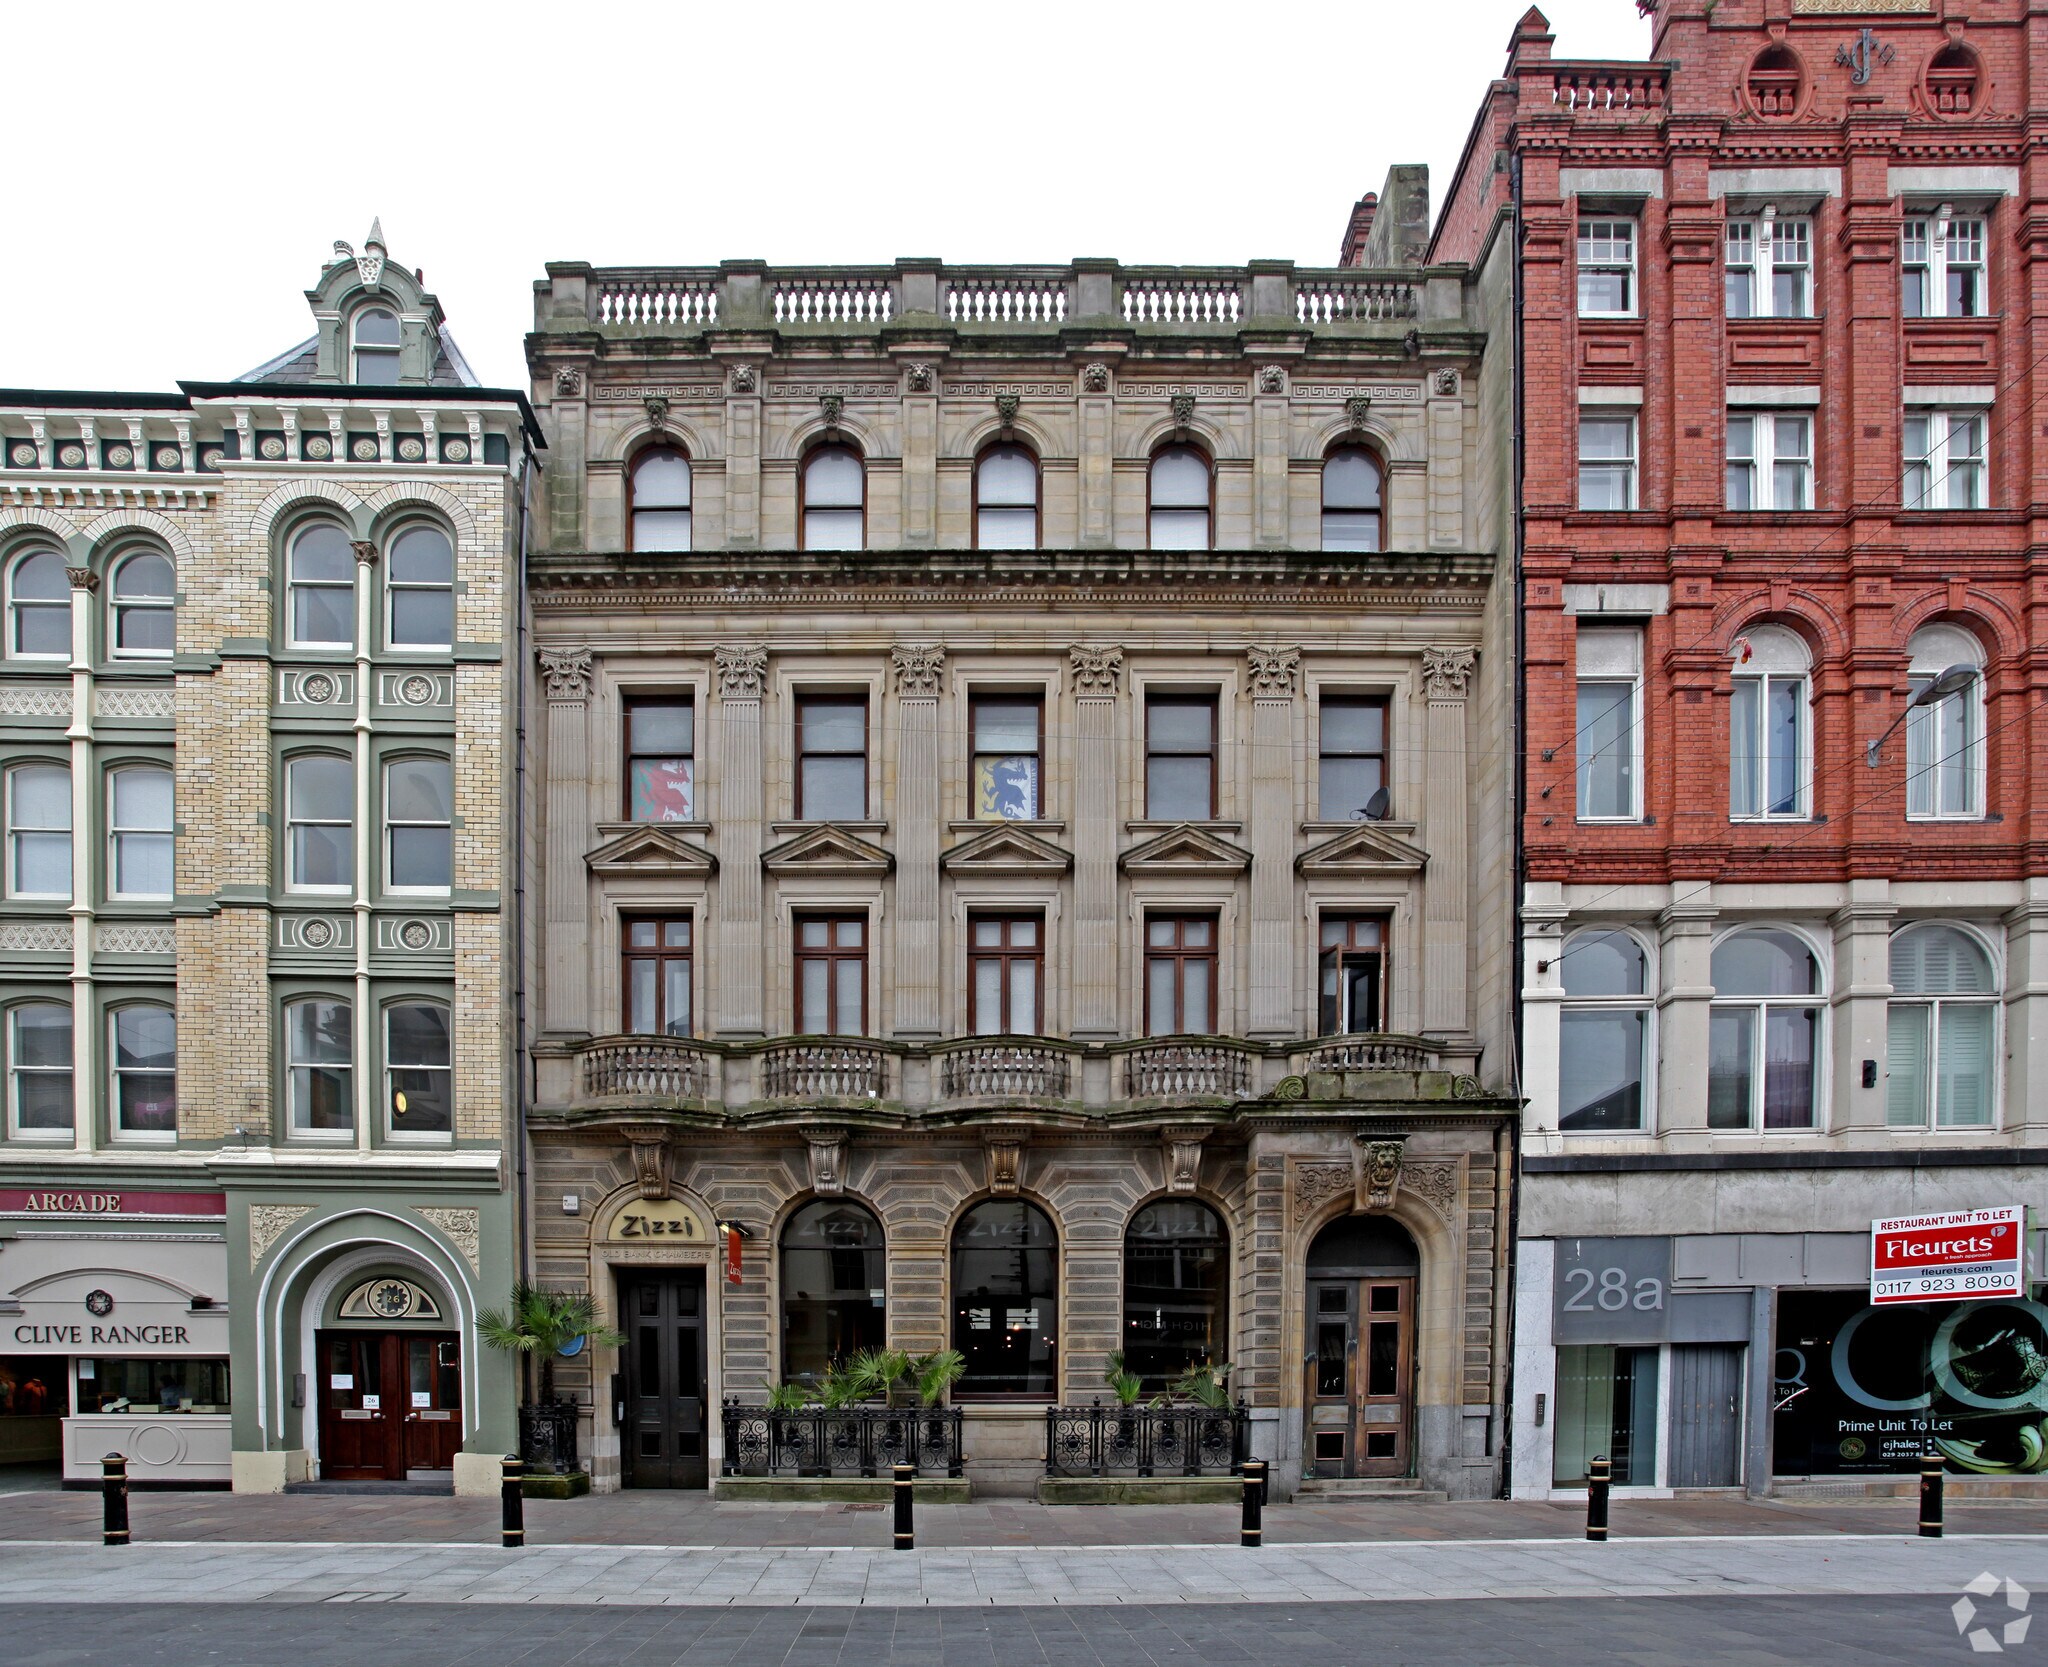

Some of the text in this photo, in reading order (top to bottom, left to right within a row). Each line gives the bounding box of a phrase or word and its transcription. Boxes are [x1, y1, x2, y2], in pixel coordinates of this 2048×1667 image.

[24, 1193, 120, 1212] ARCADE
[620, 1215, 693, 1237] Zizzi
[1880, 1210, 2012, 1230] RESTAURANT UNIT TO LET
[601, 1250, 711, 1259] OLD BANK CHAMBERS
[1885, 1236, 1993, 1259] Fleurets
[1921, 1264, 1992, 1276] fleurets.com
[1563, 1267, 1664, 1312] 28a
[1876, 1274, 2016, 1294] 0117 923 8090
[386, 1295, 400, 1303] 26
[14, 1326, 190, 1344] CLIVE RANGER
[1838, 1418, 1953, 1432] Prime Unit To Let
[1883, 1440, 1920, 1450] ejhales
